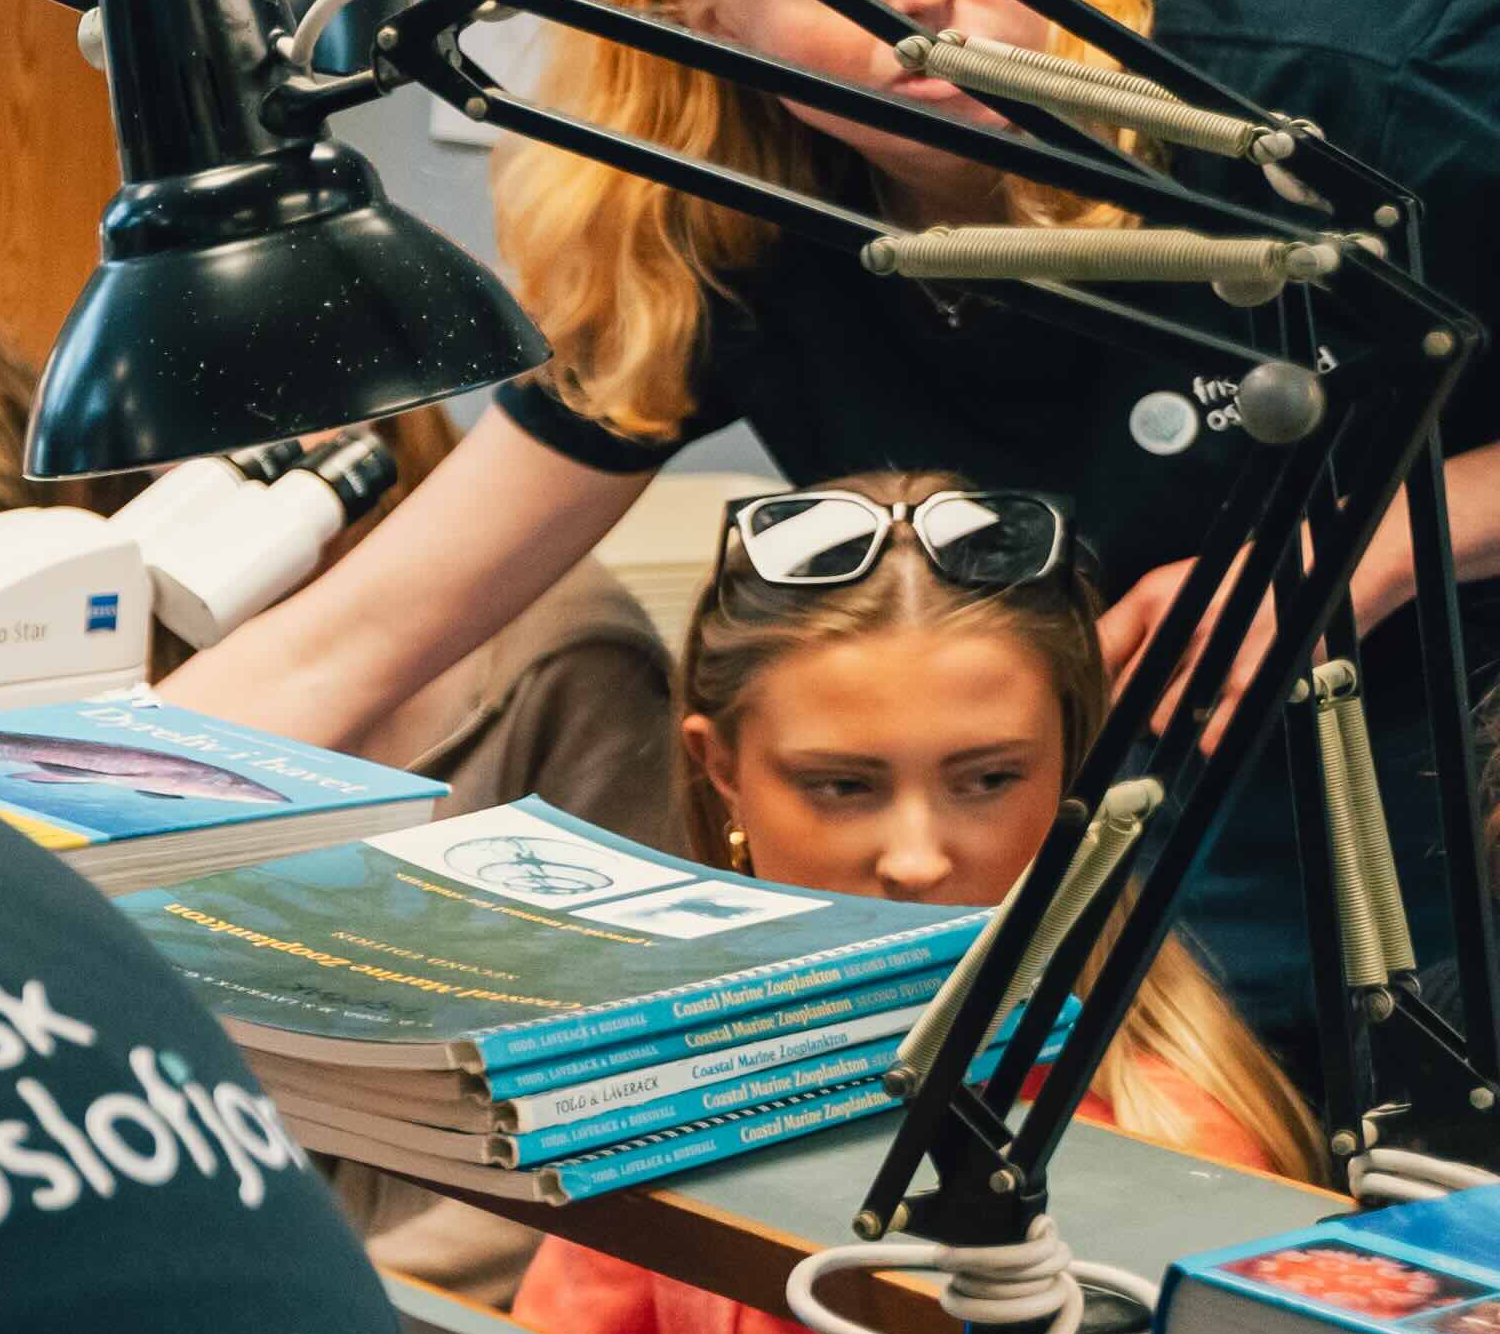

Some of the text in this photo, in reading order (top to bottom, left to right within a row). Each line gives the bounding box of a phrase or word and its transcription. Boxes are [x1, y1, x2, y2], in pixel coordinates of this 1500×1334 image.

[14, 619, 48, 644] Star
[77, 705, 231, 754] Dyreliv
[257, 754, 369, 796] havet
[166, 902, 351, 968] Zooplankton
[349, 961, 456, 997] Marine
[455, 987, 582, 1011] Coastal
[673, 993, 719, 1020] Coastal
[719, 985, 765, 1012] Marine
[765, 966, 842, 999] Zooplankton
[685, 1022, 736, 1050] Coastal
[736, 1014, 777, 1041] Marine
[777, 997, 853, 1029] Zooplankton
[603, 1076, 660, 1103] LAVERACK
[691, 1056, 736, 1080] Coastal
[736, 1047, 778, 1072] Marine
[778, 1031, 849, 1063] Zooplankton
[703, 1083, 749, 1109] Coastal
[749, 1075, 793, 1101] Marine
[793, 1055, 869, 1088] Zooplankton
[740, 1120, 782, 1144] Coastal
[782, 1108, 823, 1134] Marine
[823, 1089, 892, 1121] Zooplankton
